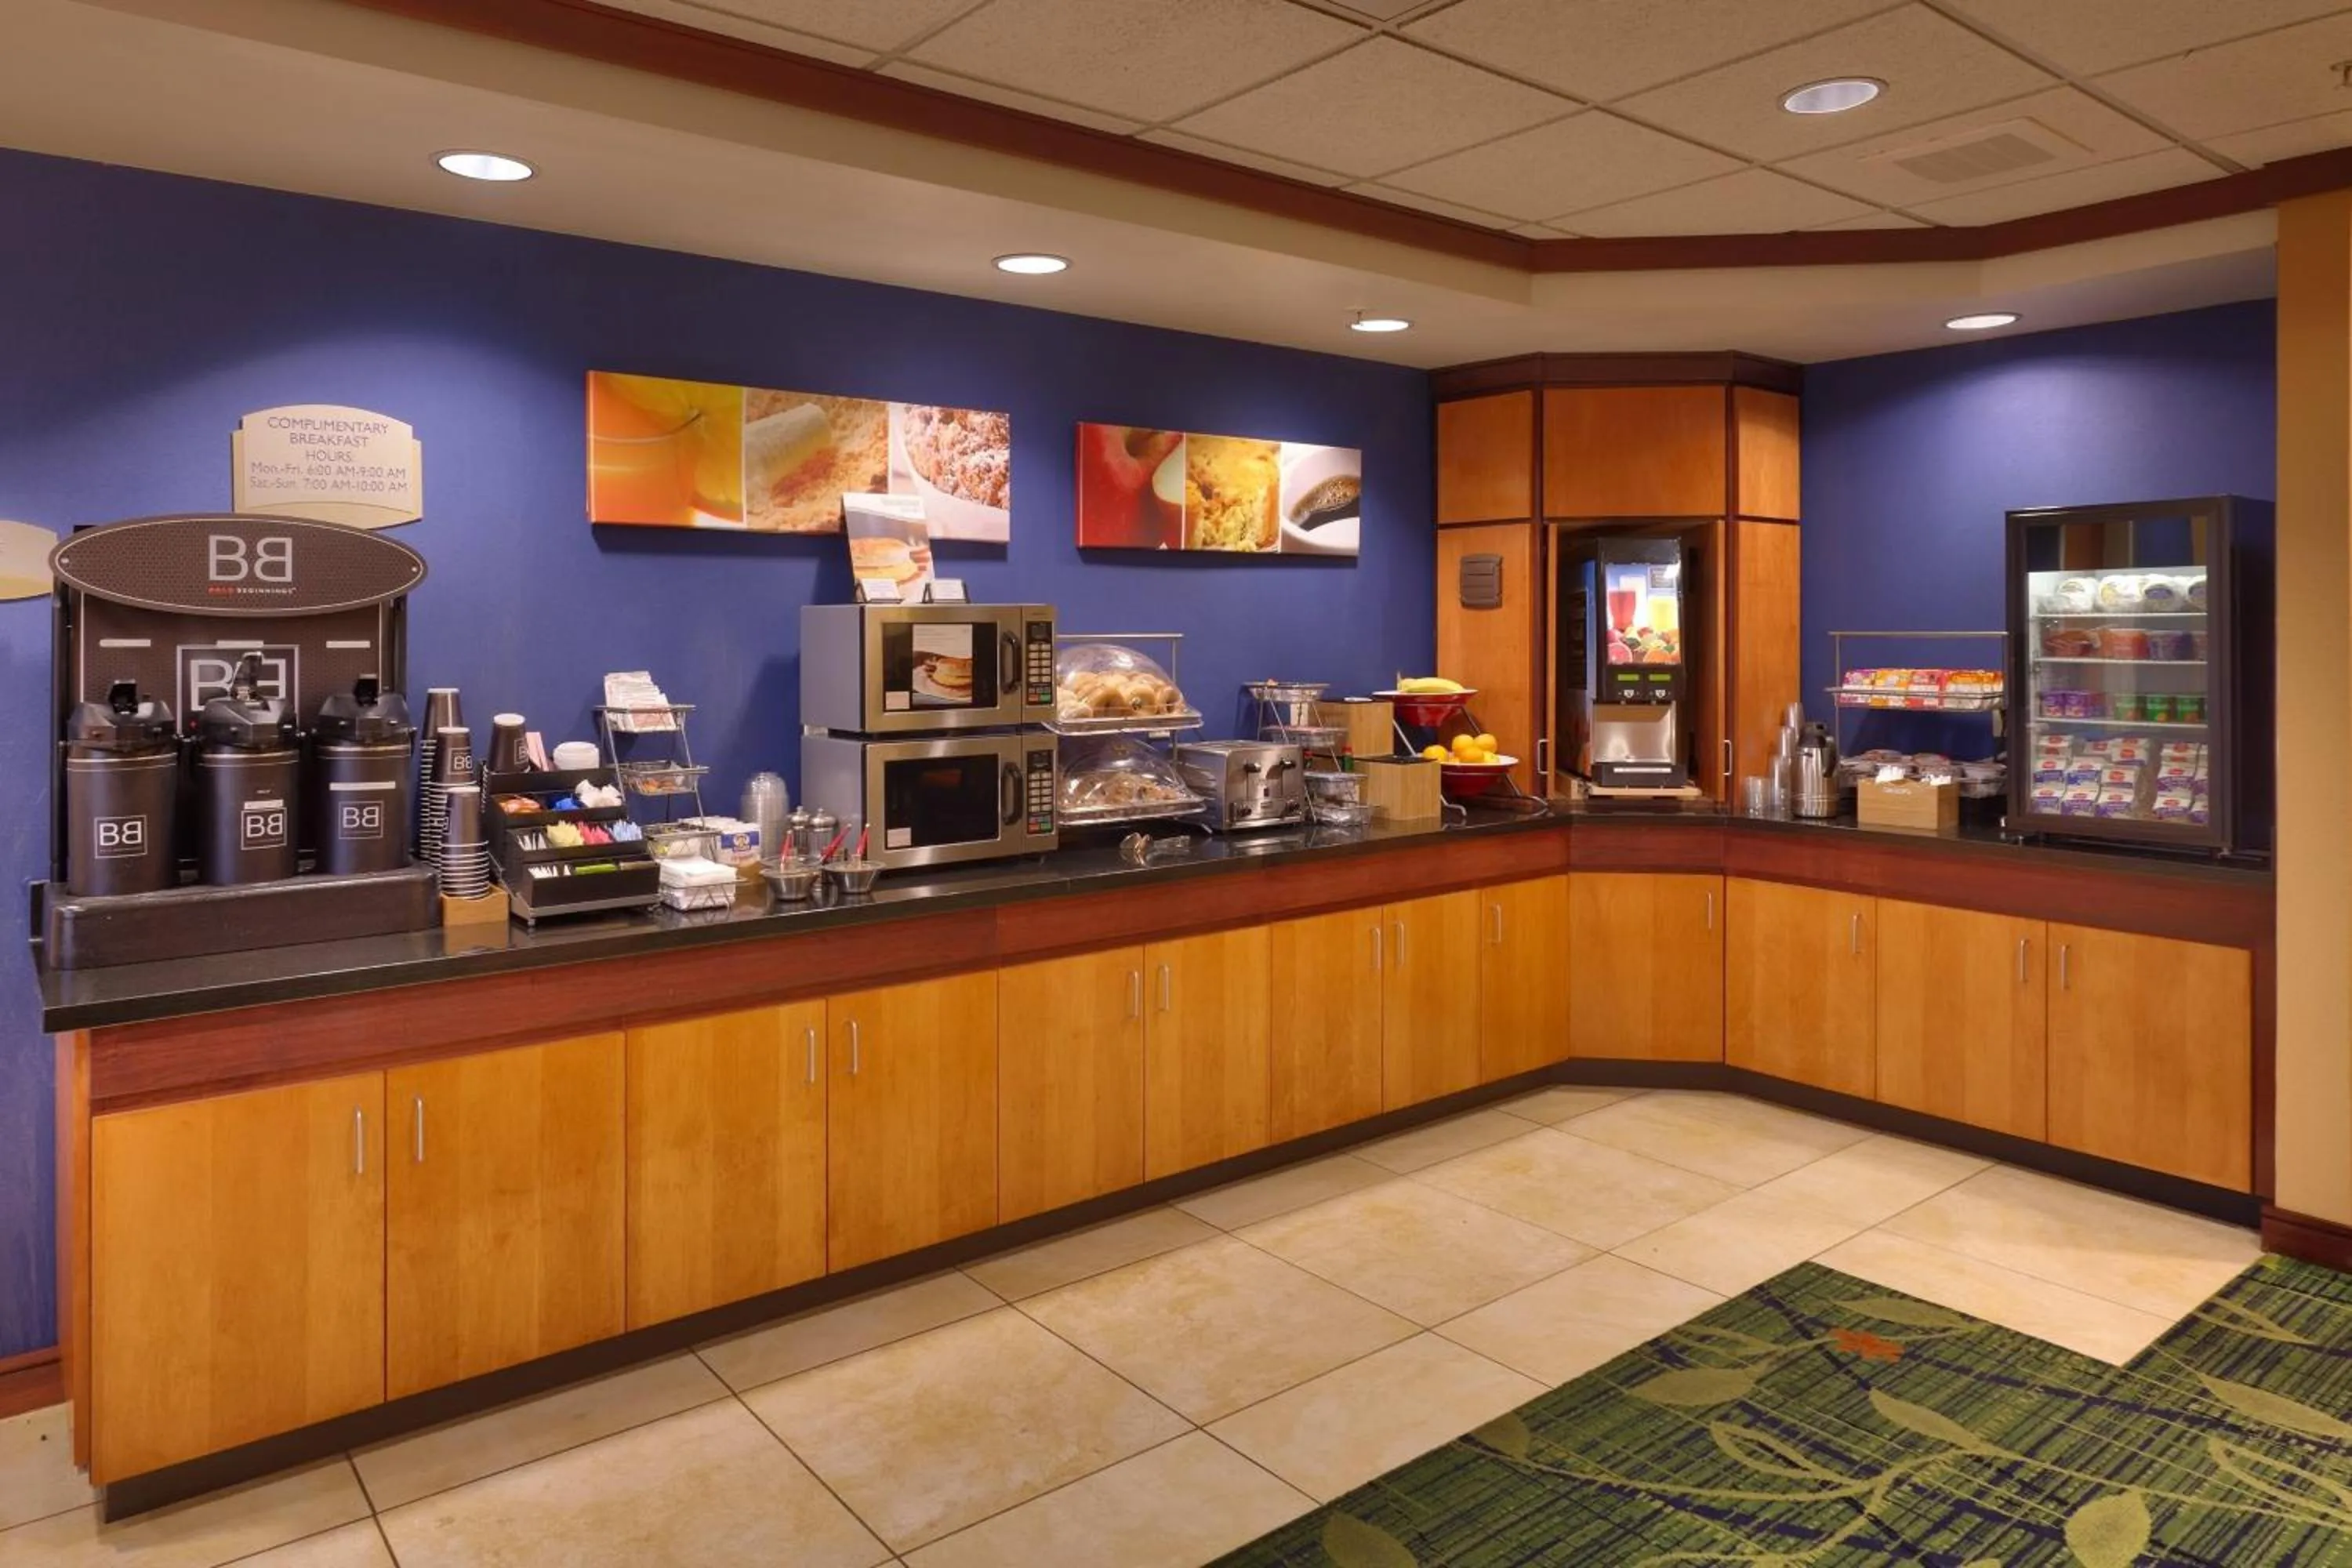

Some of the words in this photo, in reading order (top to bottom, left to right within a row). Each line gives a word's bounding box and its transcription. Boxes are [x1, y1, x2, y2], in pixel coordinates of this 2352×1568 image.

[267, 416, 389, 434] COMPLIMENTARY
[289, 432, 369, 448] BREAKFAST
[306, 450, 352, 462] HOURS
[387, 467, 406, 479] AM
[388, 481, 408, 492] AM
